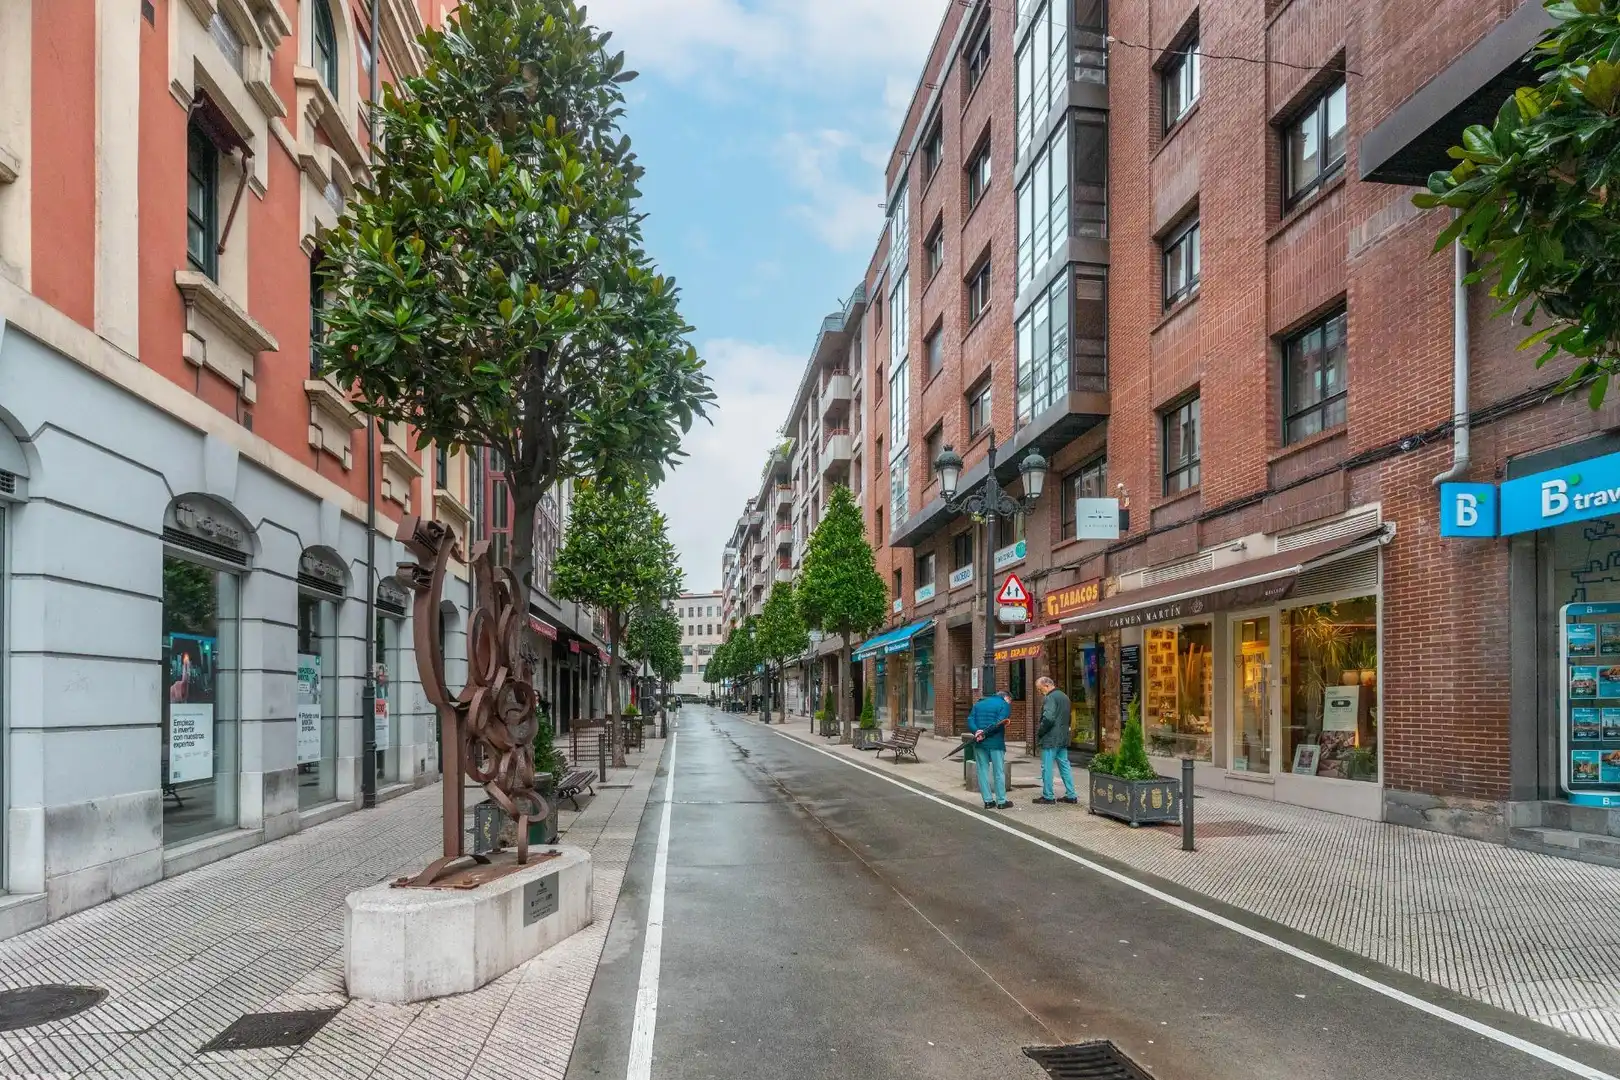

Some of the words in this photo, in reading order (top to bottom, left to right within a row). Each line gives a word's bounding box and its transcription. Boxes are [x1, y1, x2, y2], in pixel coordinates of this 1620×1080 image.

[1456, 493, 1478, 527] B
[1060, 583, 1098, 608] TABACOS
[1109, 615, 1141, 628] CARMEN
[1146, 604, 1181, 620] MARTÍN
[173, 718, 195, 727] Empieza
[173, 741, 195, 749] expertos
